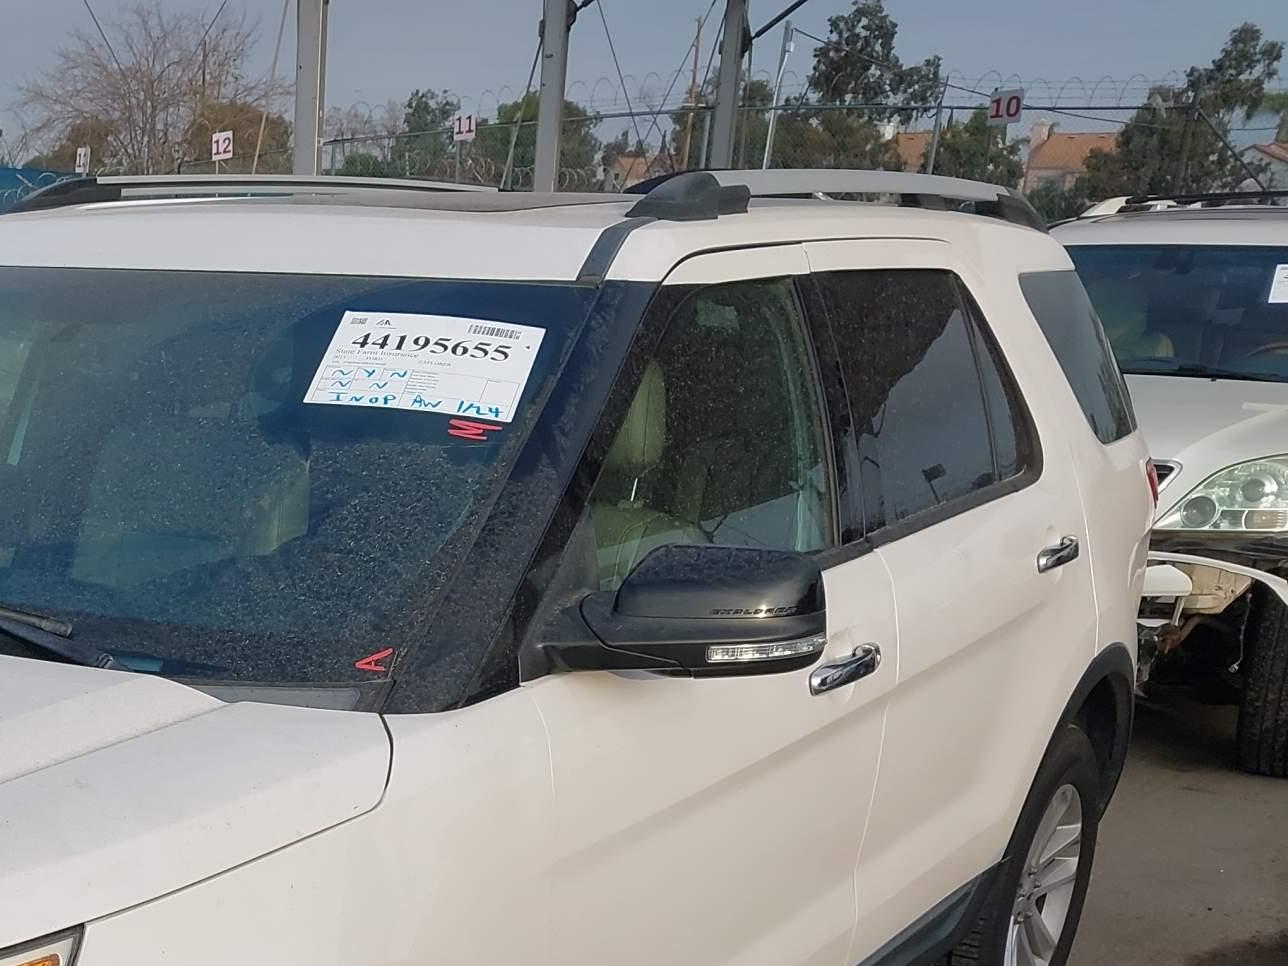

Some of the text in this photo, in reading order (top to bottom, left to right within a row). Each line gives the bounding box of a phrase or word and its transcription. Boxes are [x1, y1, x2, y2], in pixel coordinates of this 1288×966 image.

[990, 95, 1021, 118] 10
[455, 114, 473, 135] 11
[213, 136, 232, 156] 12
[351, 331, 512, 361] 44195655
[456, 400, 504, 418] 1/24
[710, 606, 798, 617] EXPLORER
